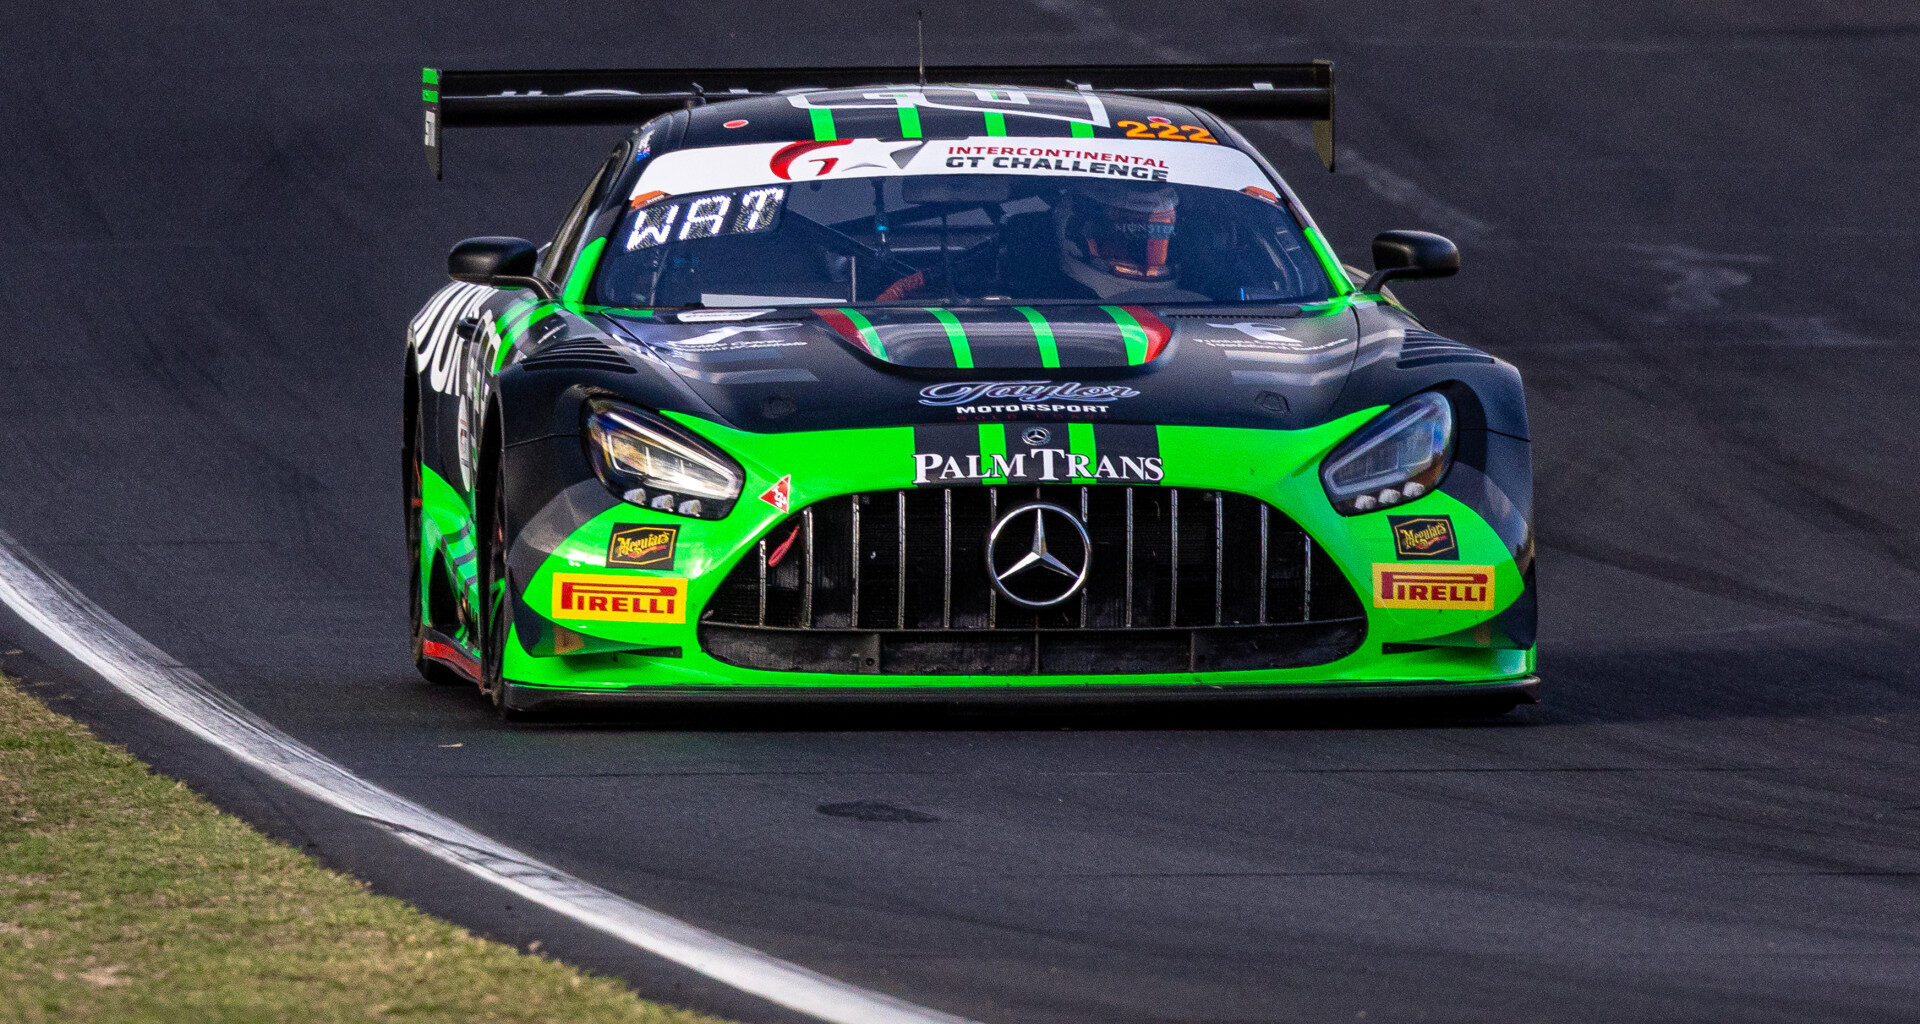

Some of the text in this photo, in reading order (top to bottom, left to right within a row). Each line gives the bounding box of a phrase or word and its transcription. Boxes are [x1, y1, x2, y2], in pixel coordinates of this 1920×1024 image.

[1118, 120, 1218, 143] 222
[945, 156, 1168, 182] GT CHALLENGE
[948, 146, 1169, 169] INTERCONTINENTAL
[625, 186, 785, 251] WAT
[918, 380, 1141, 407] Taylor
[955, 404, 1110, 414] MOTORSPORT
[561, 581, 678, 614] PIRELLI
[1381, 571, 1488, 602] PIRELLI
